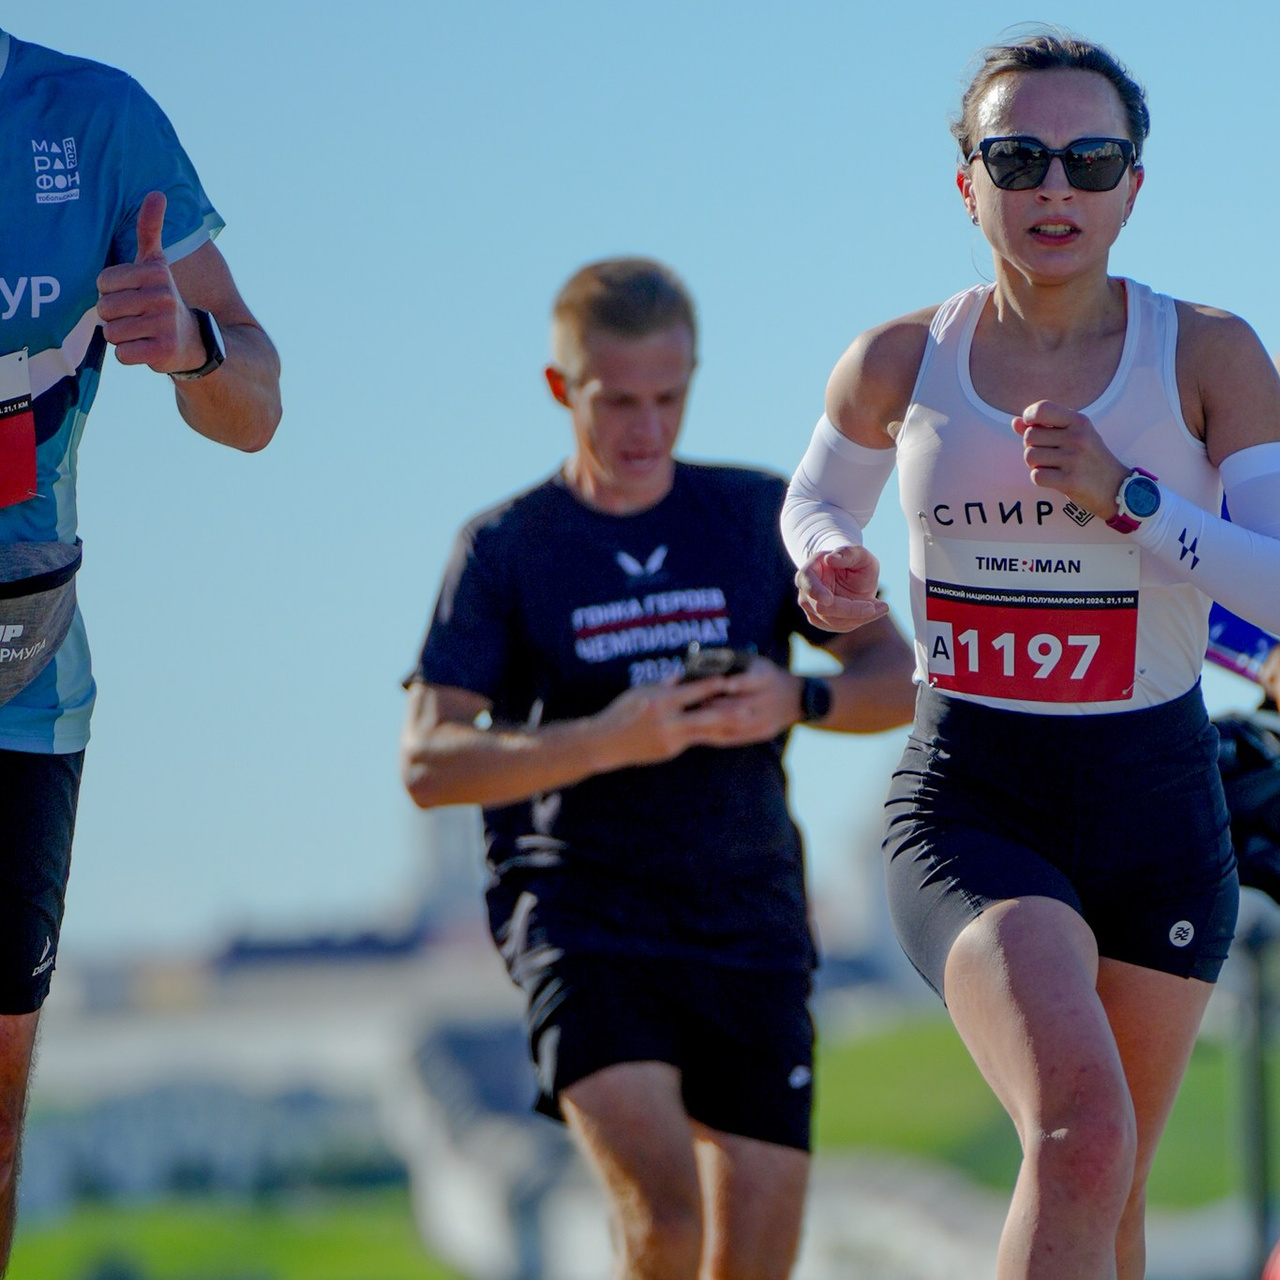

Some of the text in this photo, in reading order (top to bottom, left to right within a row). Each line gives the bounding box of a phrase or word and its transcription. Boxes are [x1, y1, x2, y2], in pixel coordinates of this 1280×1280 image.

[64, 139, 77, 167] 2023
[929, 586, 966, 599] КАЗАНСКИЙ
[966, 592, 1026, 604] НАЦИОНАЛЬНЫЙ
[1026, 596, 1085, 604] ПОЛУМАРАФОН
[1107, 597, 1121, 606] 21,1
[574, 616, 730, 664] ЧЕМПИОНАТ
[957, 628, 1101, 681] 1197
